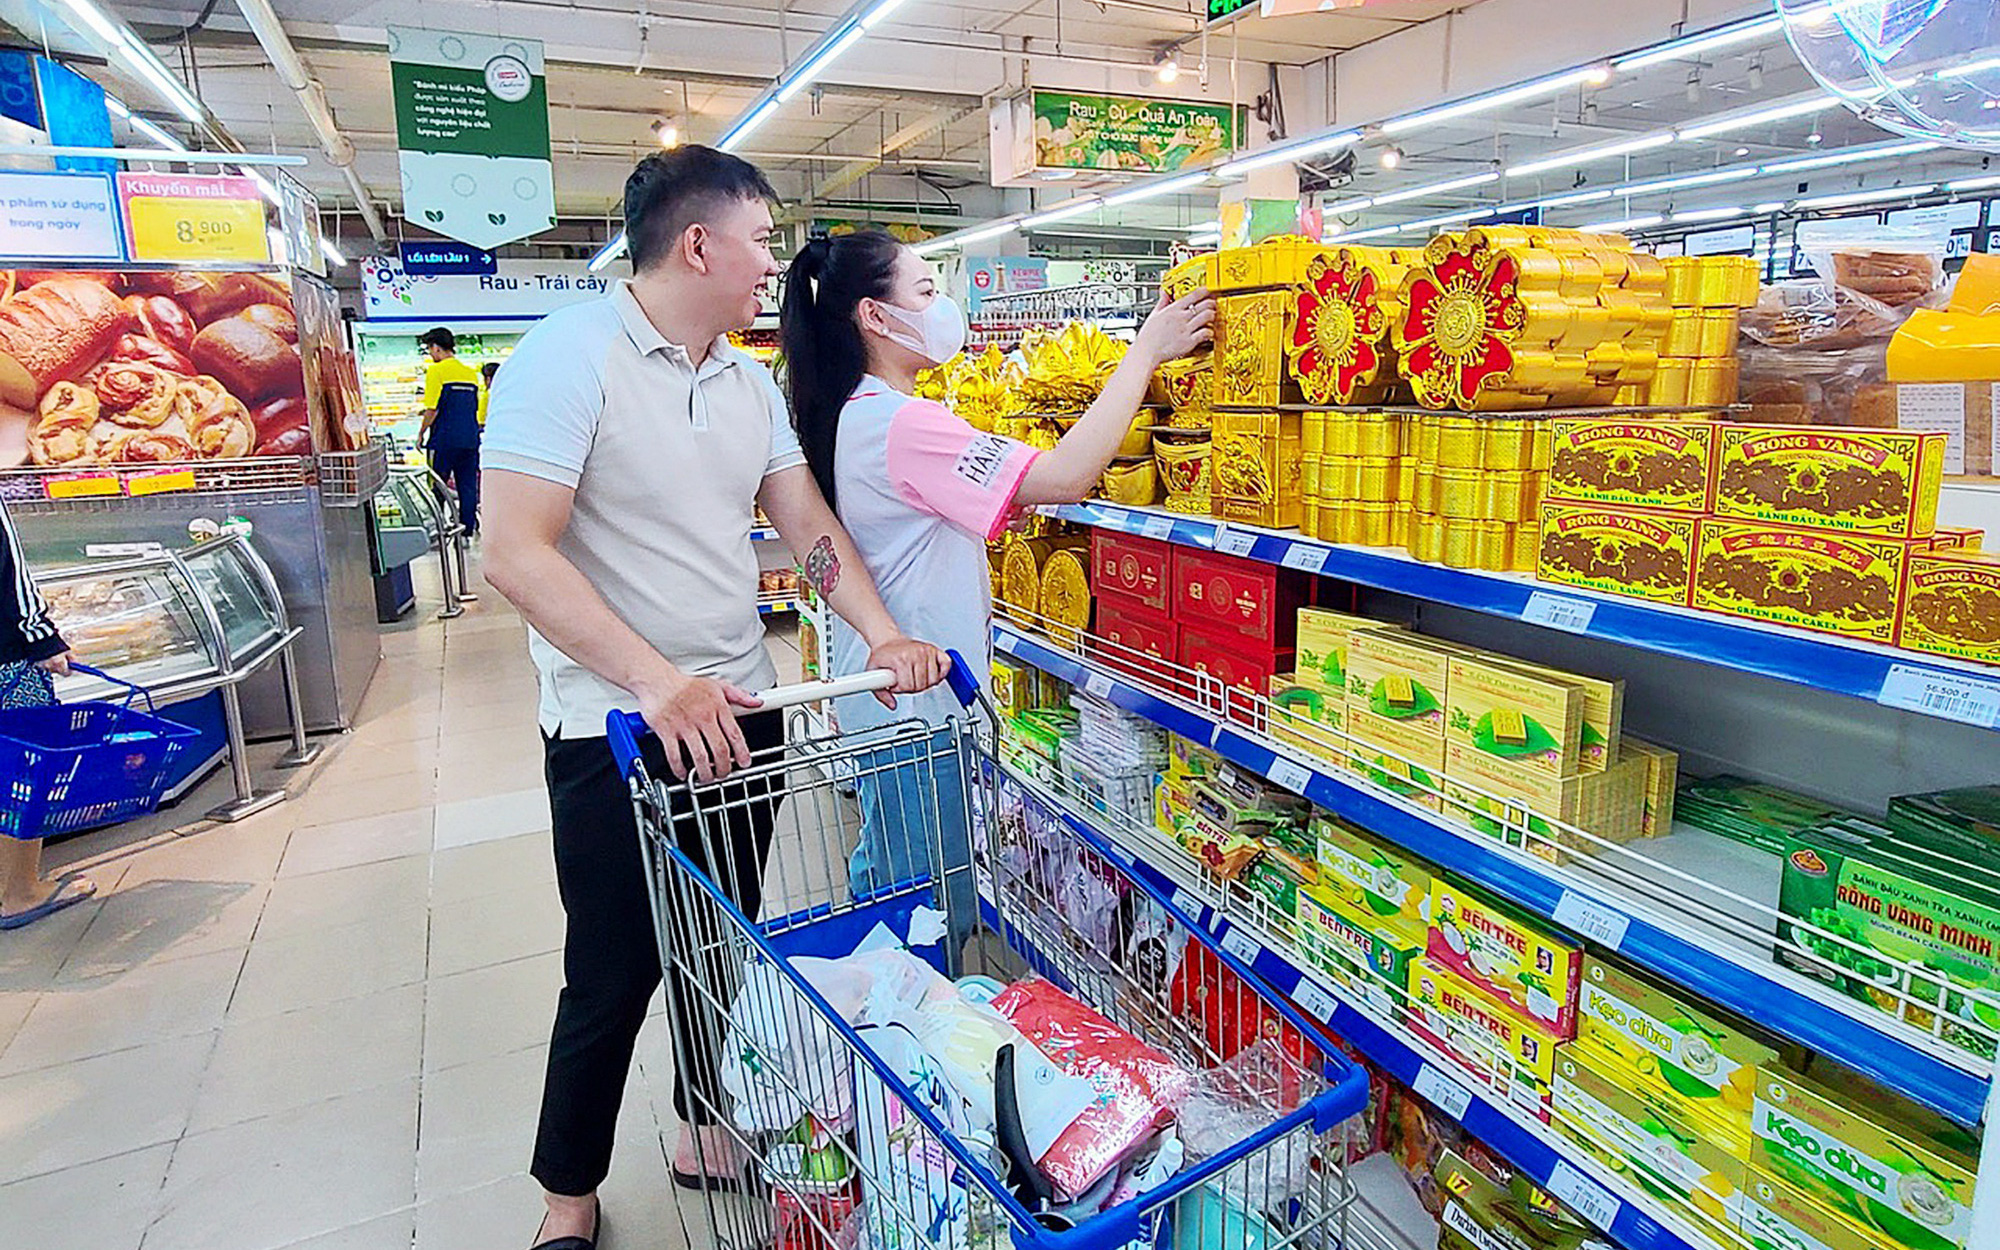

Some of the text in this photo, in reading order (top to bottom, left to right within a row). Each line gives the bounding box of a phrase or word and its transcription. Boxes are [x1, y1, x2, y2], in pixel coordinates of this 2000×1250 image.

[1070, 101, 1097, 118] Rau
[1138, 107, 1165, 123] Quả
[1168, 109, 1185, 125] An
[1188, 109, 1219, 127] Toàn
[126, 181, 190, 197] Khuyến
[72, 197, 106, 213] dụng
[9, 218, 44, 230] trong
[177, 220, 232, 243] 8 900
[480, 275, 518, 291] Rau
[535, 273, 570, 291] Trái
[576, 274, 608, 294] cây
[1634, 497, 1662, 506] XANH
[1819, 518, 1854, 529] XANH
[1620, 587, 1646, 596] XANH
[1737, 606, 1838, 630] GREEN BEAN CAKES
[1902, 890, 1929, 908] XANH
[1954, 910, 1983, 927] XANH
[1940, 922, 1992, 957] MINH
[1588, 990, 1627, 1026] Kẹo
[1629, 1016, 1673, 1053] dừa
[1766, 1110, 1822, 1155] Kẹo
[1825, 1146, 1887, 1195] dừa
